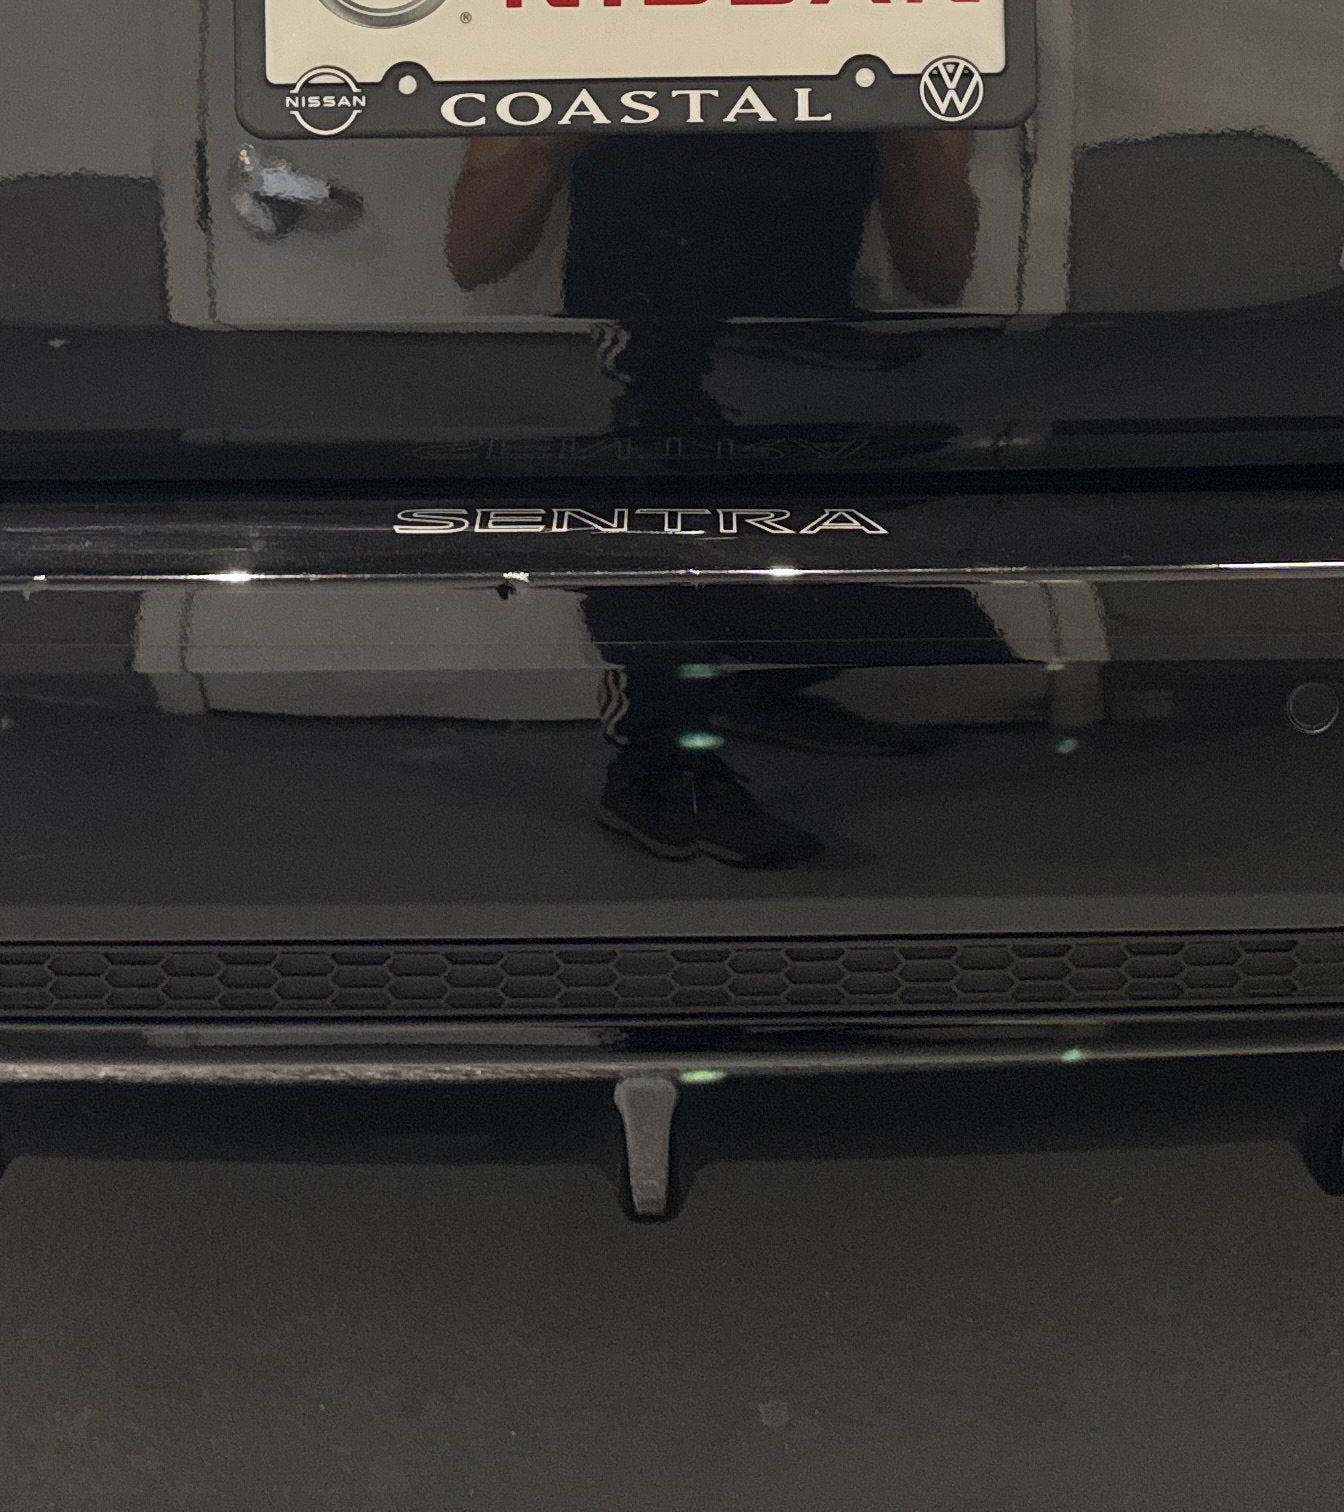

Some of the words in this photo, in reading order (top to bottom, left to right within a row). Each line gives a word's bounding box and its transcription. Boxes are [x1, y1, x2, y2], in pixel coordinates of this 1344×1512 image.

[285, 94, 367, 108] NISSAN
[440, 85, 833, 127] COASTAL
[392, 507, 889, 535] SENTRA
